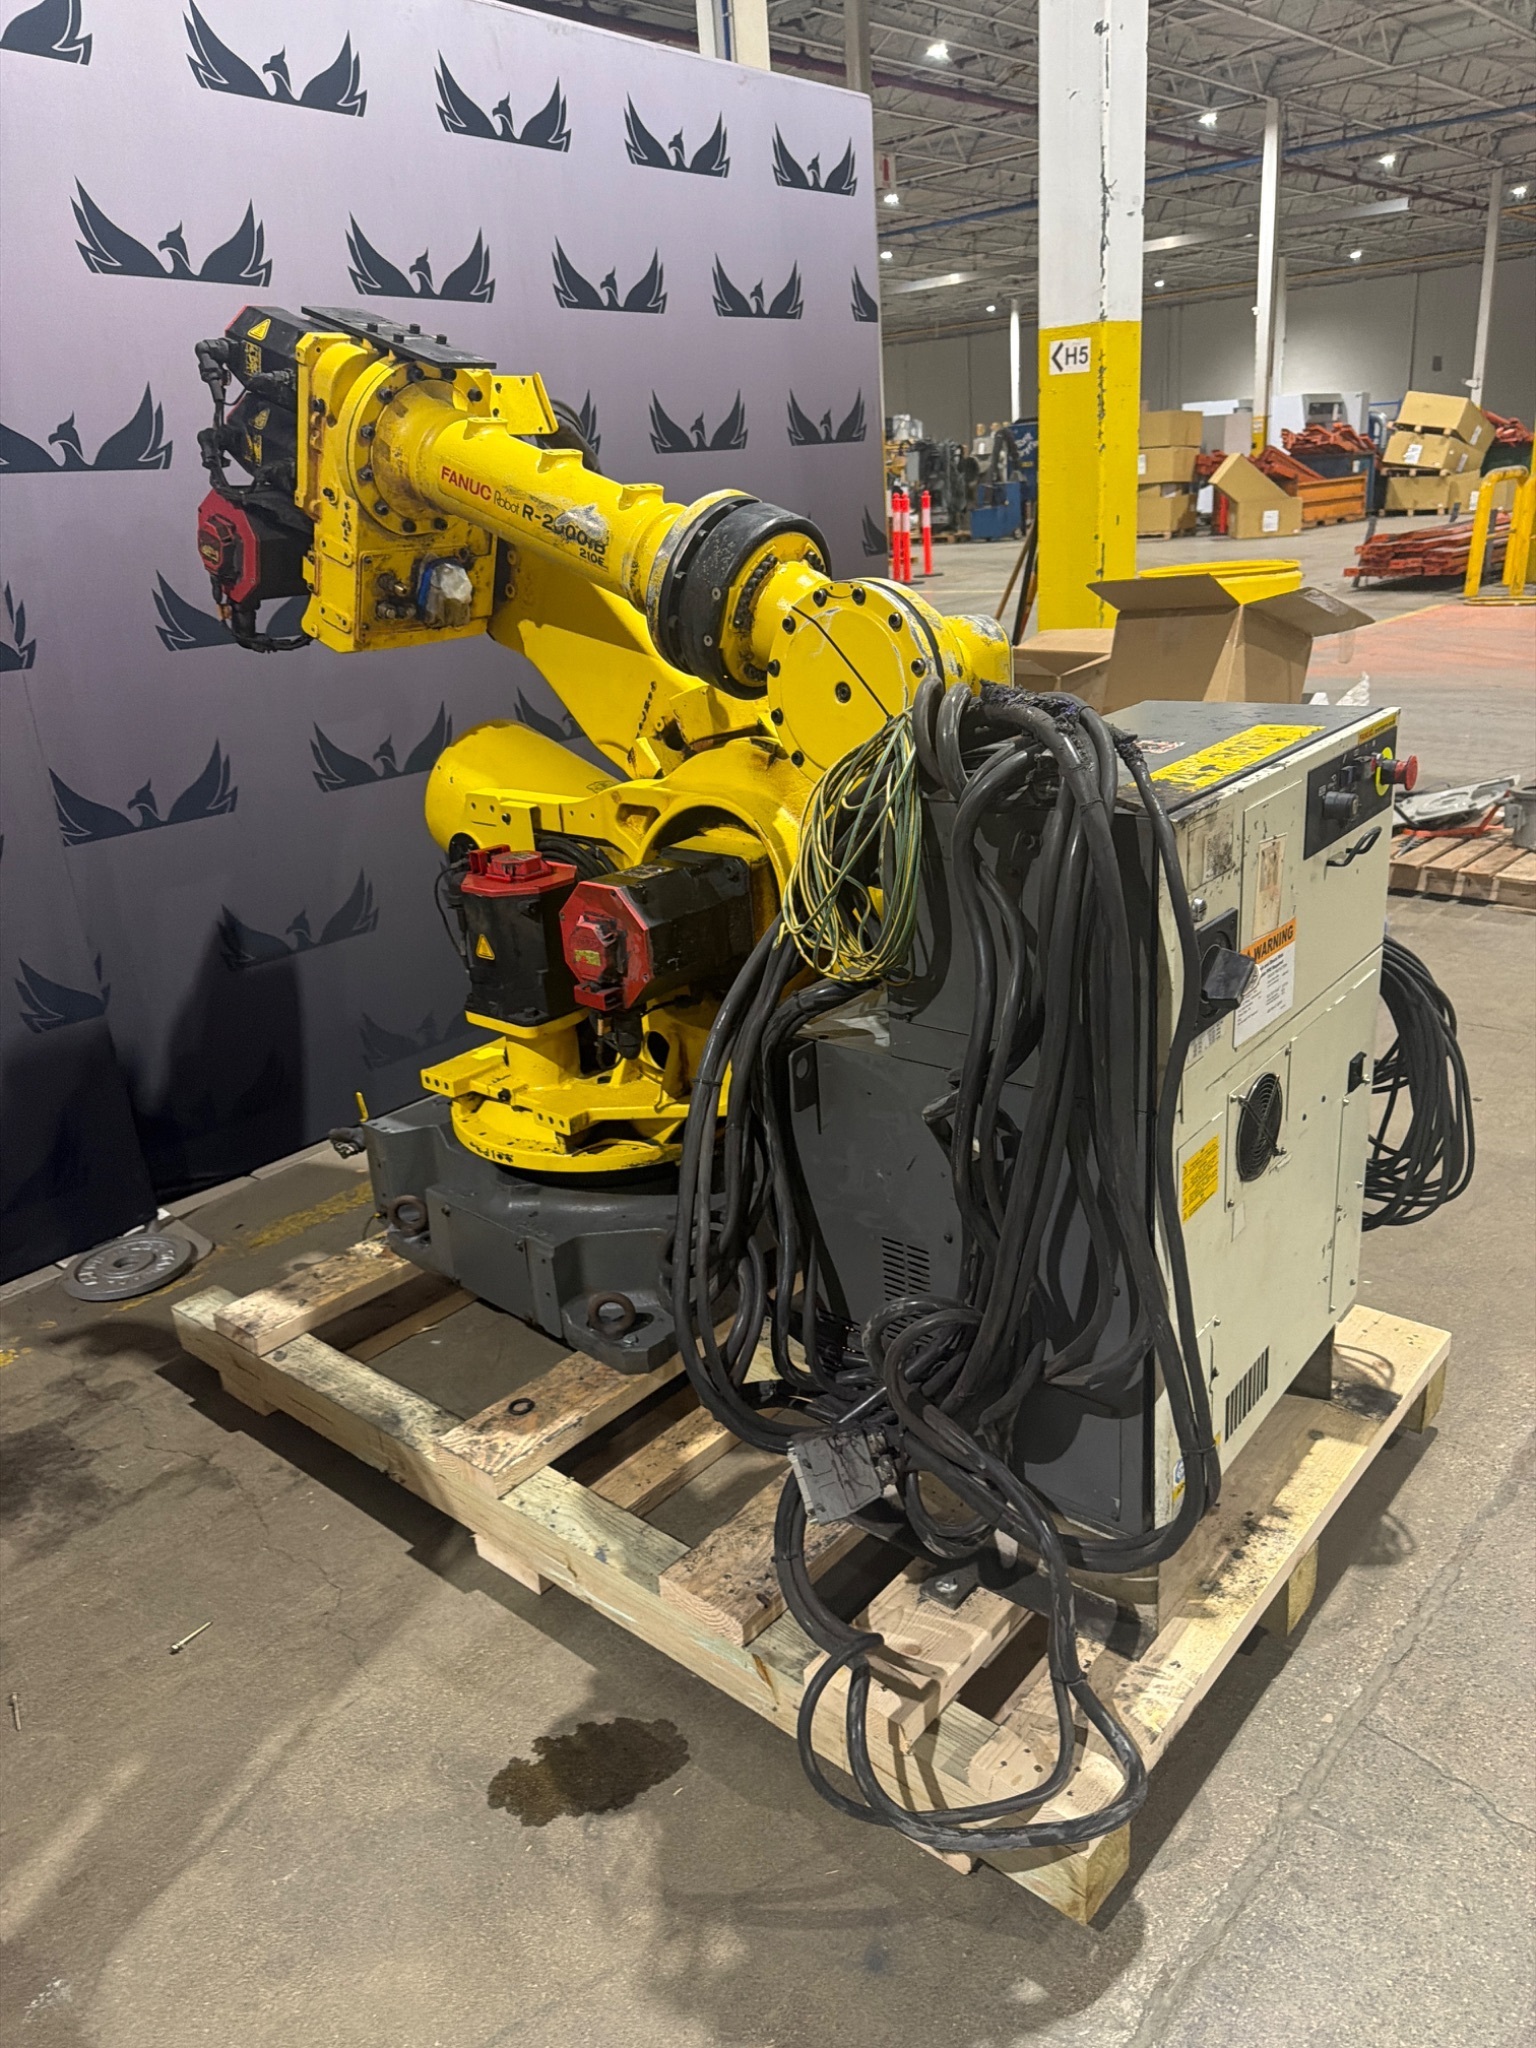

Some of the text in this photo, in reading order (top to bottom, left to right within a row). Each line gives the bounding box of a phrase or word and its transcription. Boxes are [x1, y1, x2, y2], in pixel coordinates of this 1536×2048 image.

[1065, 346, 1088, 365] H5
[441, 466, 492, 501] FANUC
[493, 490, 520, 515] Robot
[579, 548, 605, 567] 210E
[1253, 925, 1294, 961] WARNING
